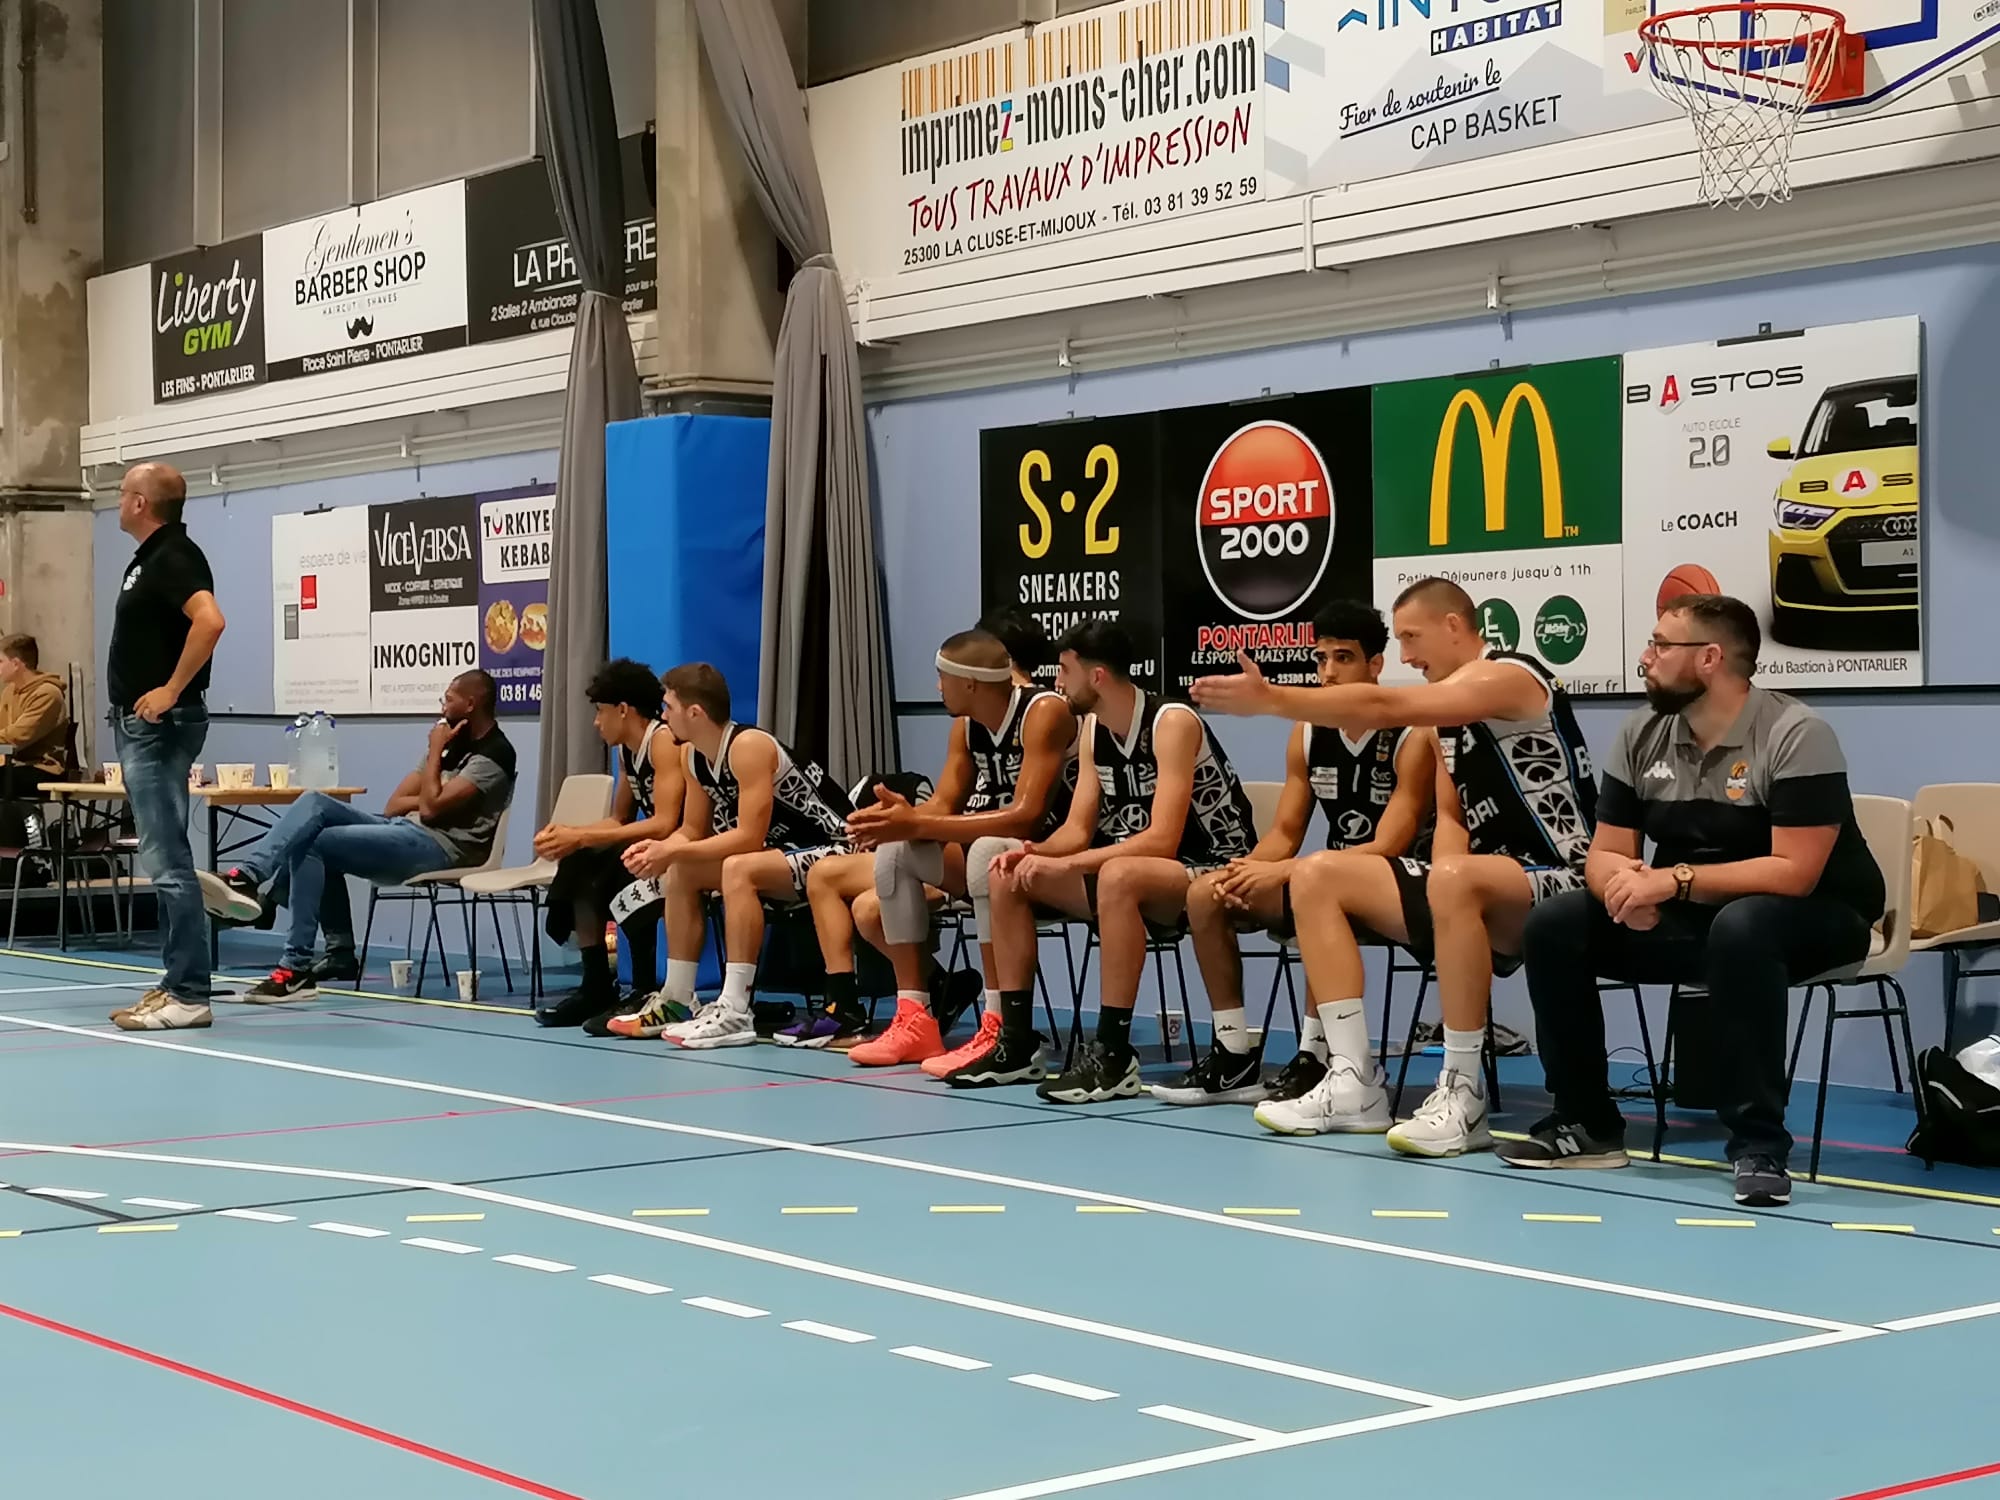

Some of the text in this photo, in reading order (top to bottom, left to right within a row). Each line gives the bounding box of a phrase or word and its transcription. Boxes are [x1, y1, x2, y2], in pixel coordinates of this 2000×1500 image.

[1432, 4, 1560, 53] HABITAT
[901, 34, 1257, 184] imprimez-moins-cher.com
[1339, 57, 1502, 131] Fier de soutenir le
[1411, 95, 1561, 150] CAP BASKET
[908, 103, 1252, 236] TOUS TRAVAUX D'IMPRESSION
[904, 244, 941, 265] 25300
[945, 238, 963, 257] LA
[967, 210, 1097, 253] CLUSE-ET-MIJOUX
[1112, 203, 1139, 223] Tél.
[1144, 198, 1162, 215] 03
[1168, 193, 1184, 211] 81
[1191, 187, 1209, 206] 39
[1215, 182, 1233, 201] 52
[1240, 176, 1257, 195] 59
[295, 251, 426, 305] BARBER SHOP
[513, 249, 542, 288] LA
[157, 259, 257, 346] Liberty
[490, 306, 497, 321] 2
[498, 303, 521, 320] Salles
[521, 301, 528, 315] 2
[528, 293, 577, 314] Ambiances
[183, 320, 233, 355] GYM
[302, 357, 326, 372] Place
[327, 352, 346, 370] Saint
[347, 348, 370, 366] Pierre
[376, 336, 424, 359] PONTARLIER
[161, 379, 175, 398] LES
[176, 375, 196, 395] FINS
[201, 364, 256, 390] PONTARLIER
[1627, 365, 1804, 407] BASTOS
[1682, 417, 1741, 433] AUTO ECOLE
[1689, 434, 1730, 469] 2.0
[1210, 479, 1319, 520] SPORT
[1661, 511, 1738, 532] Le COACH
[500, 542, 550, 568] KEBAB
[1220, 521, 1309, 560] 2000
[300, 552, 335, 569] espace
[337, 550, 351, 566] de
[1570, 564, 1591, 576] 11h
[1019, 570, 1120, 604] SNEAKERS
[374, 641, 475, 669] INKOGNITO
[1191, 651, 1204, 665] LE
[1206, 650, 1240, 665] SPOR
[1254, 649, 1284, 663] MAIS
[1286, 649, 1308, 663] PAS
[1769, 660, 1784, 674] du
[1786, 659, 1826, 674] Bastion
[1827, 659, 1834, 672] à
[1836, 658, 1908, 673] PONTARLIER
[500, 683, 542, 701] 03 81 46
